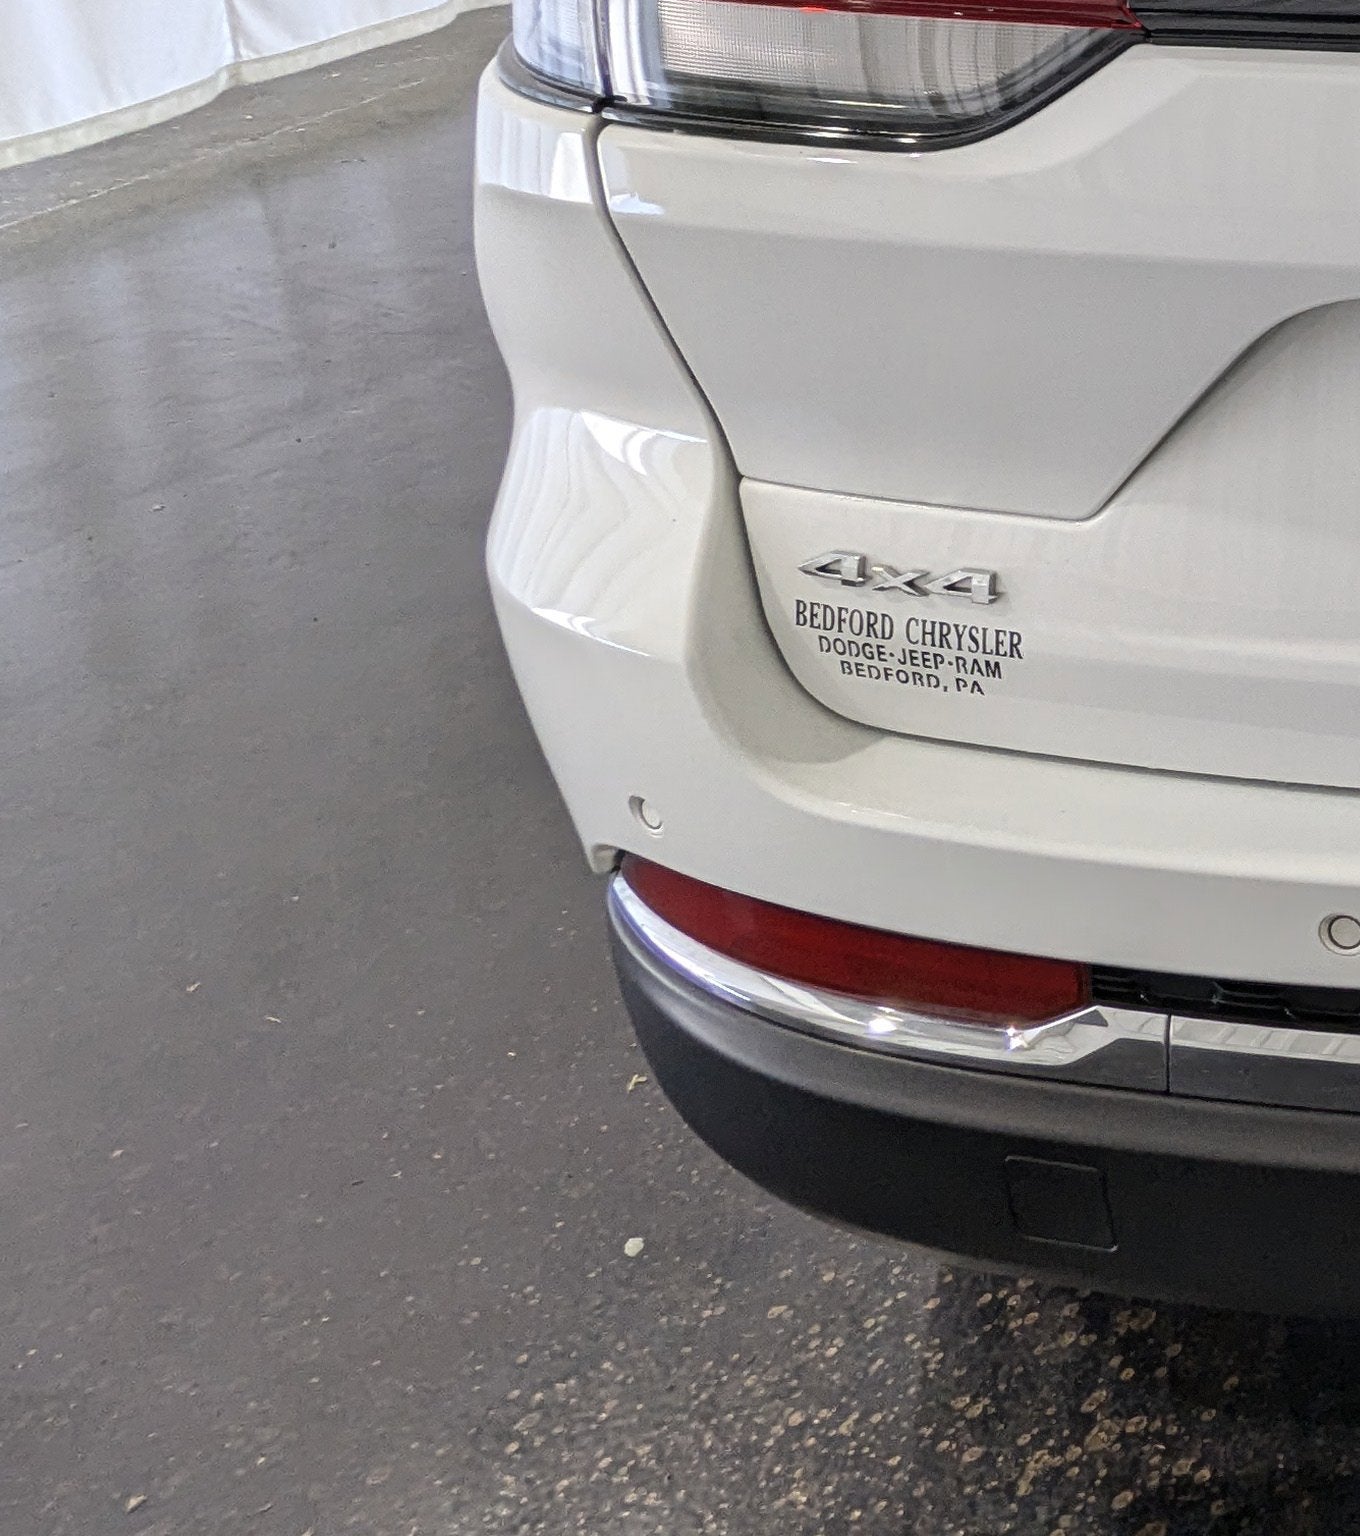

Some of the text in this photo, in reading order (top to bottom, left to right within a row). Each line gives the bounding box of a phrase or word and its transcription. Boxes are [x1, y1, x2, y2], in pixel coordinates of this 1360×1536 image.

[794, 598, 1024, 661] BEDFORD CHRYSLER
[840, 660, 986, 696] BEDFORD, PA
